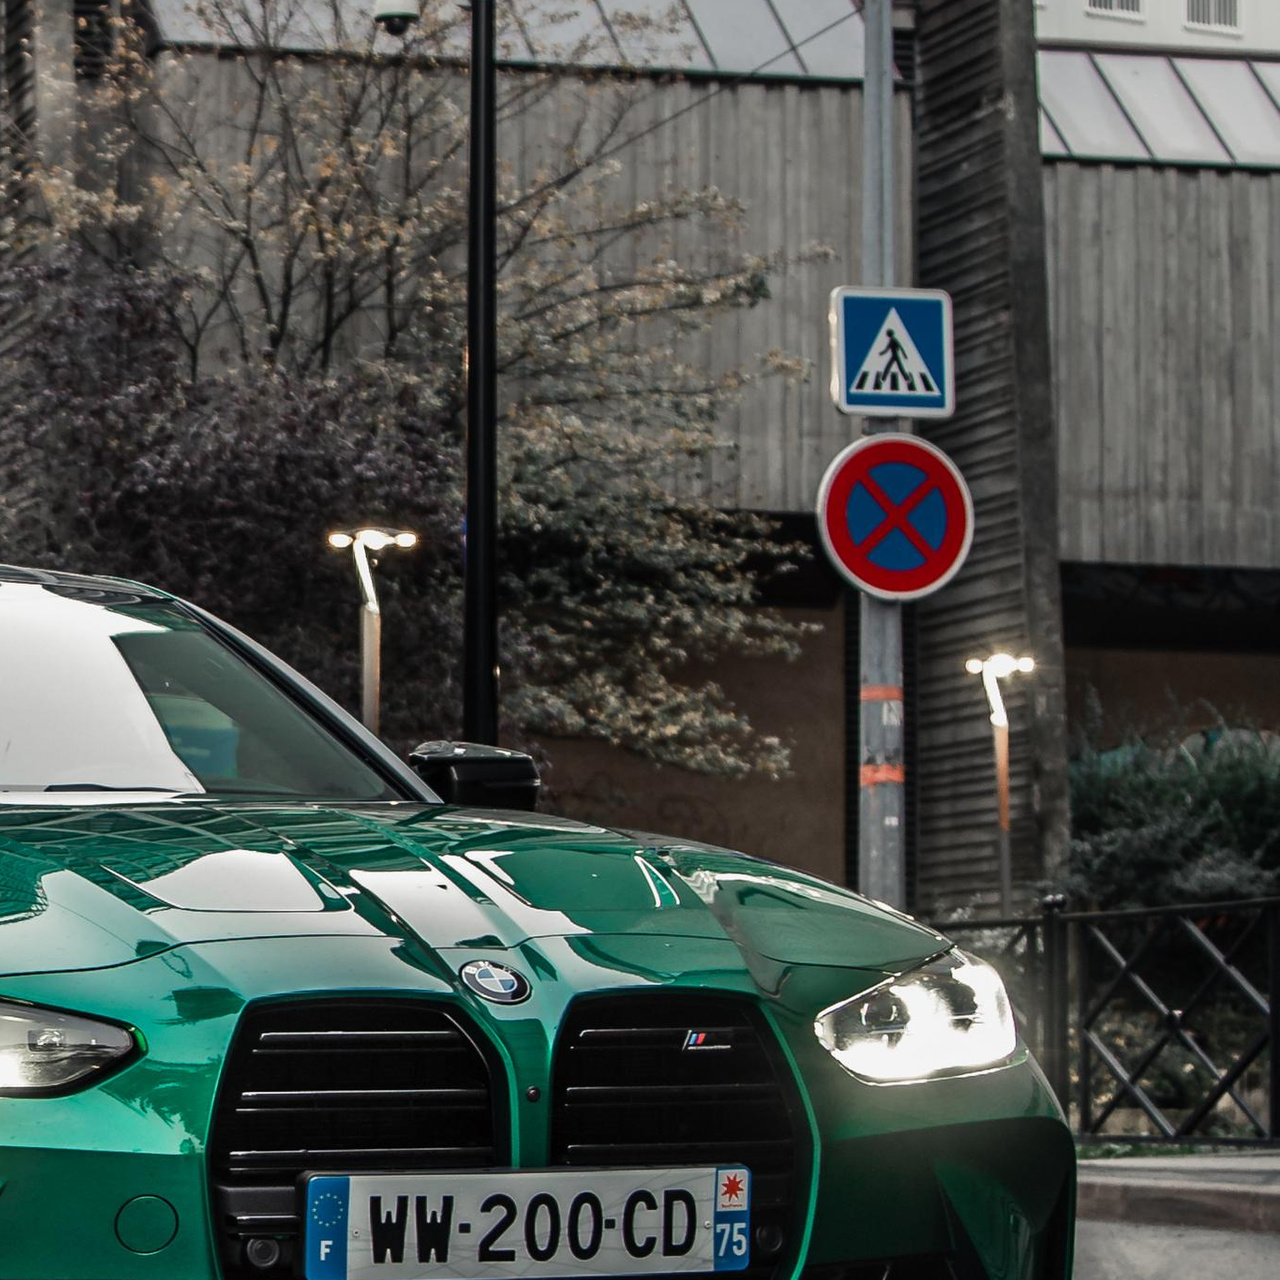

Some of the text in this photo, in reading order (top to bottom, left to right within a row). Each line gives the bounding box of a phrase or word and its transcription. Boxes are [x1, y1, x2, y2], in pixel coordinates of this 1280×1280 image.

[369, 1188, 697, 1264] WW-200-CD
[716, 1222, 747, 1257] 75
[320, 1240, 334, 1262] F
